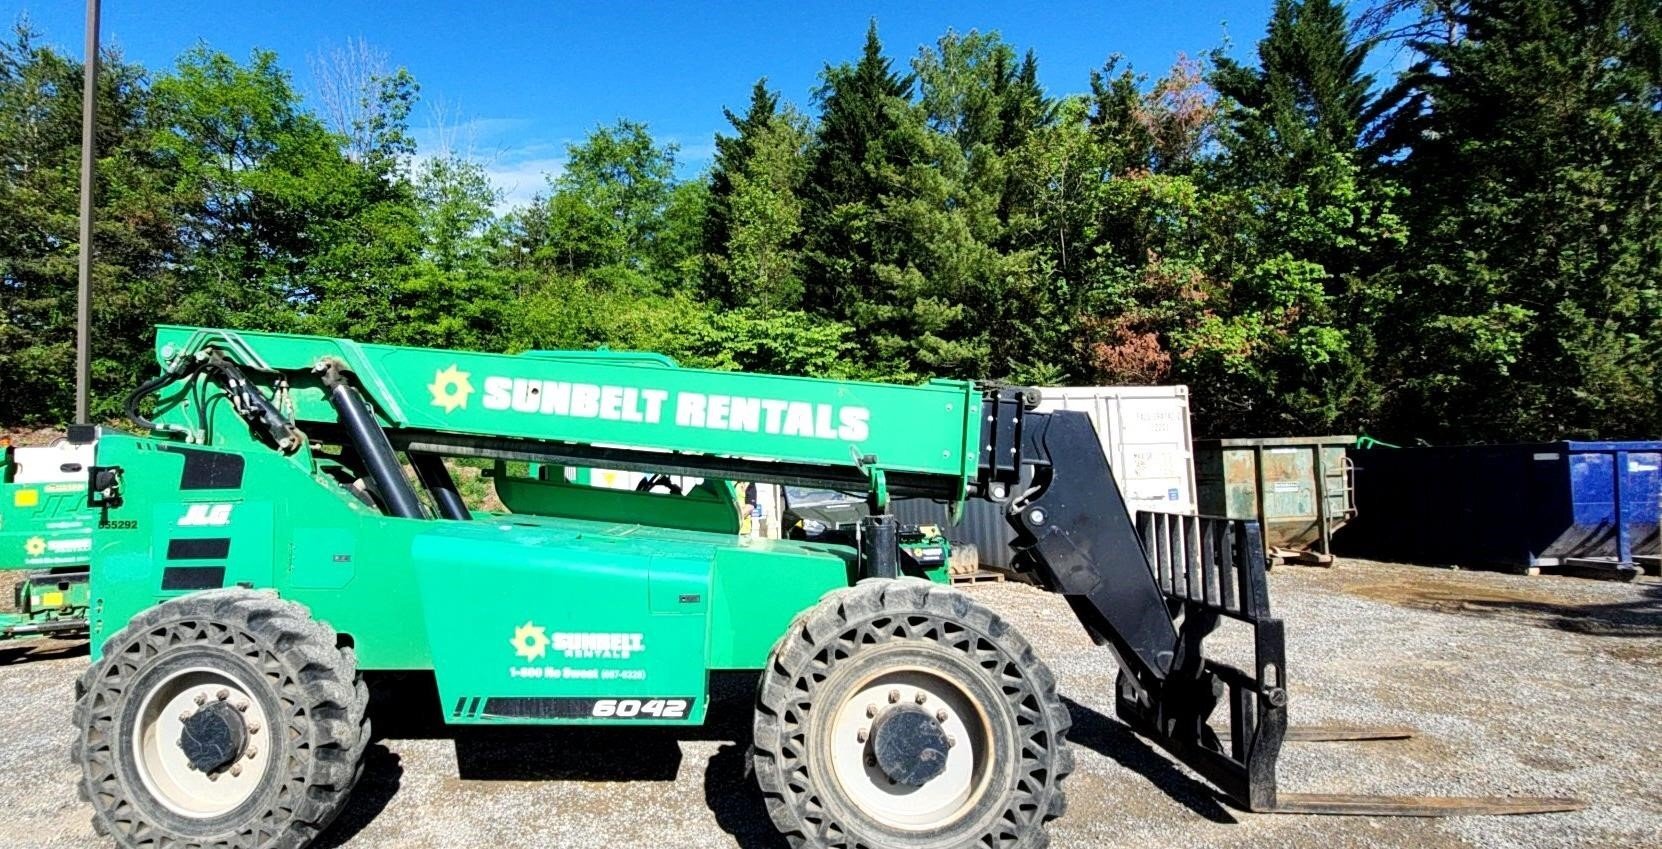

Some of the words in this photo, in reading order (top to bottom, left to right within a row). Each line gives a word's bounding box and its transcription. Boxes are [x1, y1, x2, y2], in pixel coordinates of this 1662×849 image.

[482, 375, 669, 425] SUNBELT
[675, 390, 871, 442] RENTALS
[177, 503, 233, 526] JLG
[551, 632, 645, 651] SUNBELT
[592, 699, 687, 717] 6042
